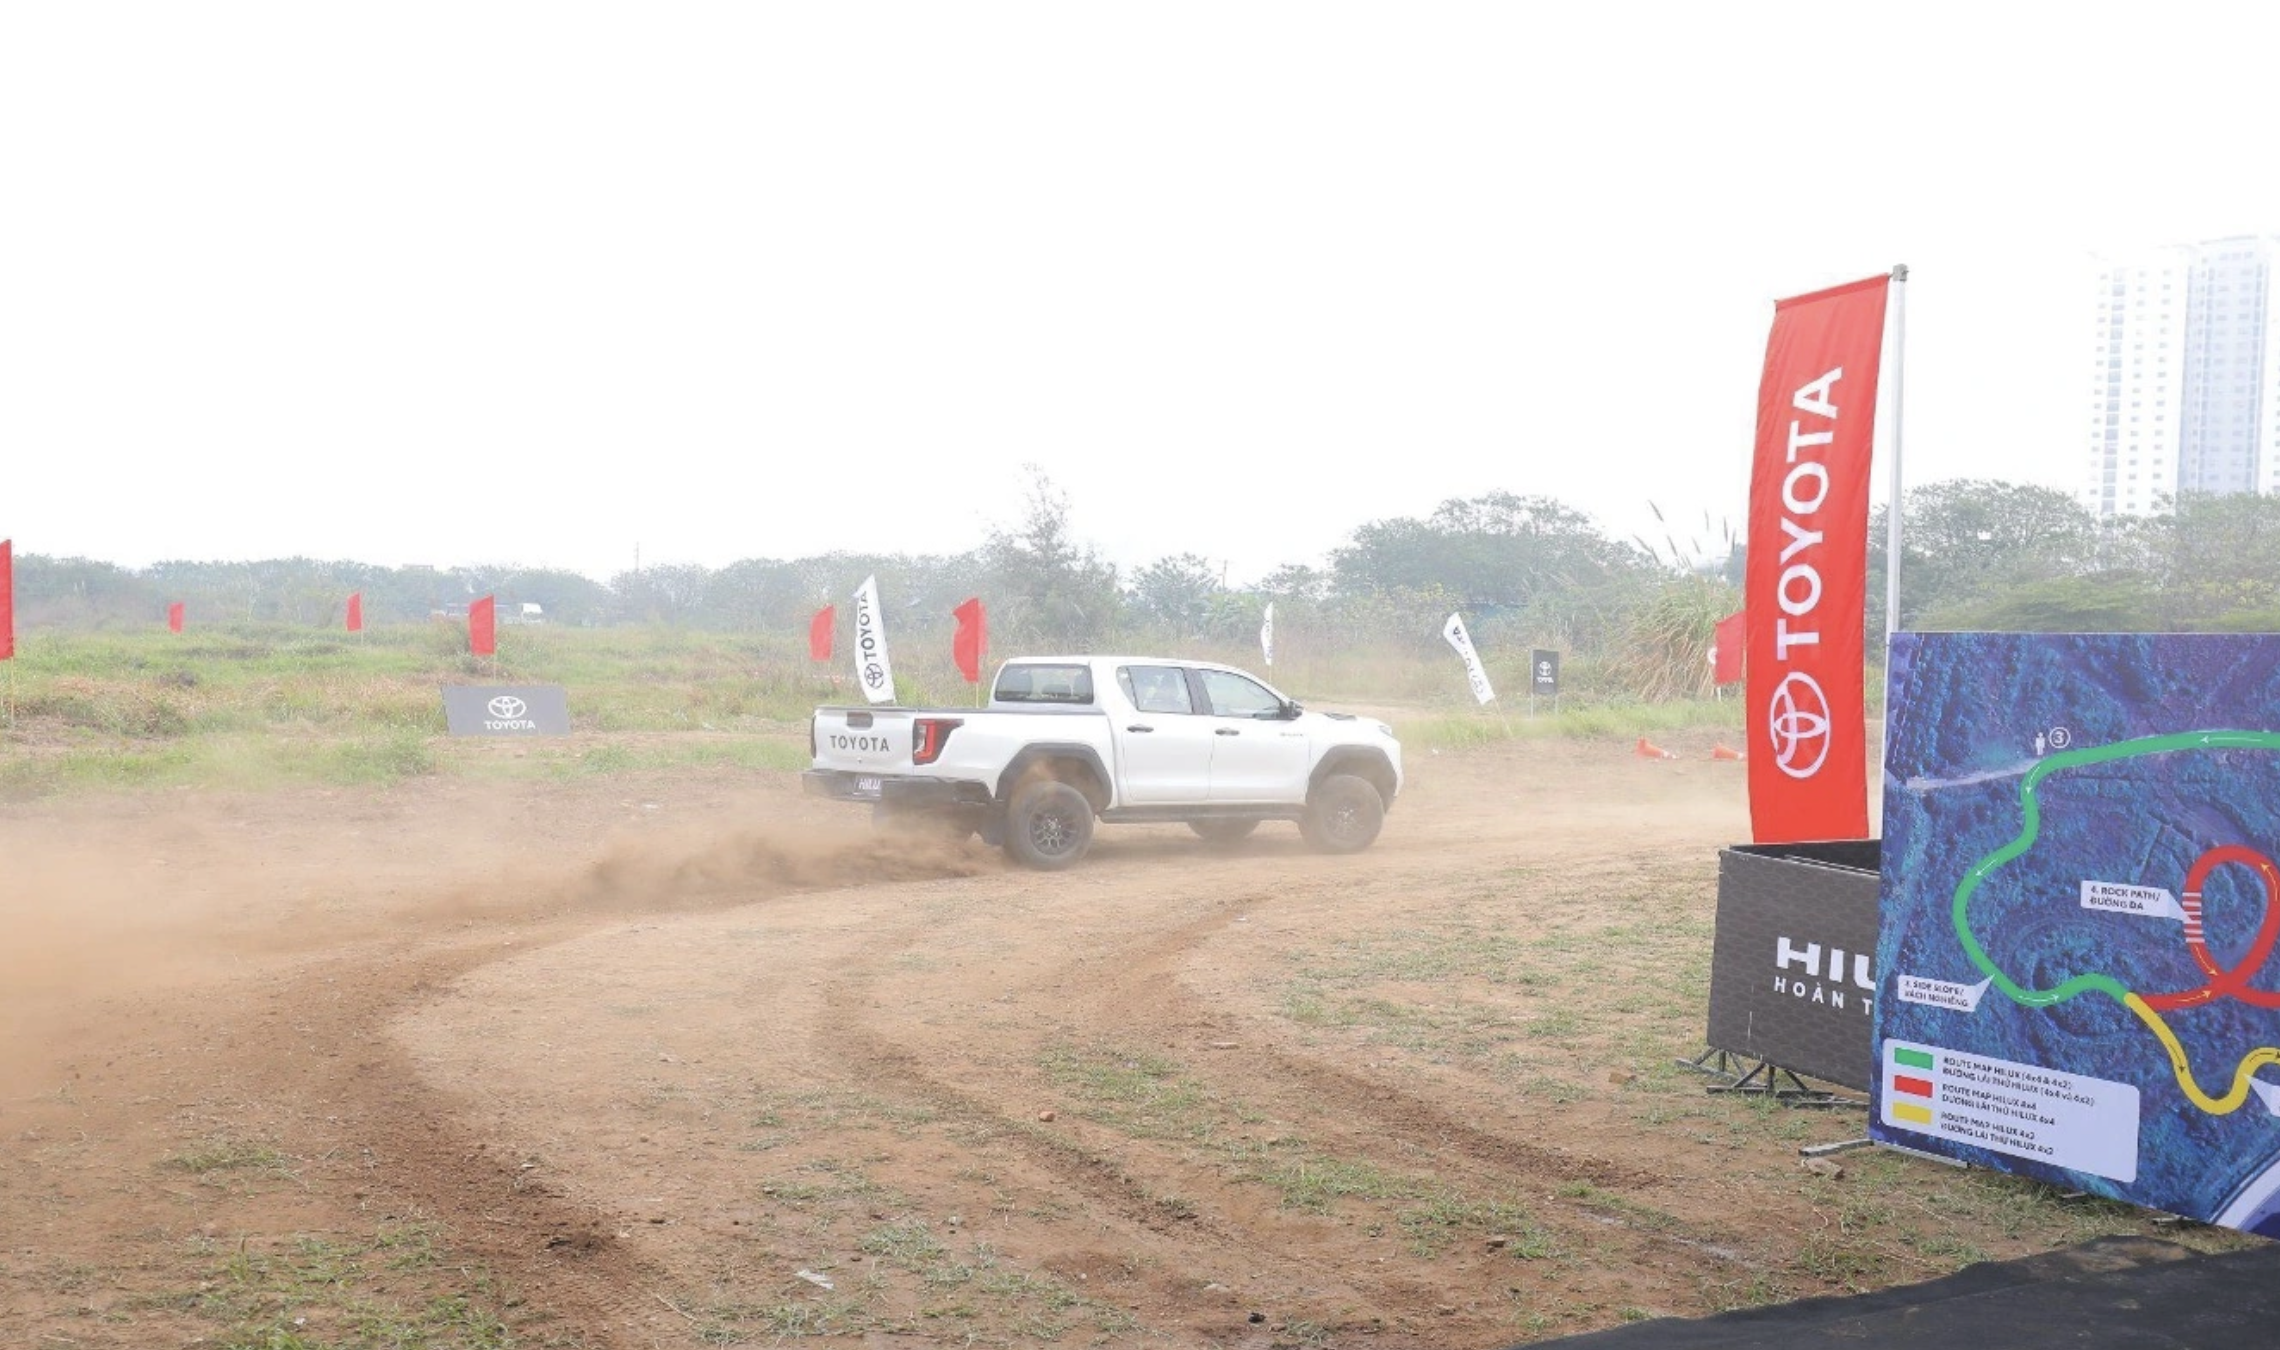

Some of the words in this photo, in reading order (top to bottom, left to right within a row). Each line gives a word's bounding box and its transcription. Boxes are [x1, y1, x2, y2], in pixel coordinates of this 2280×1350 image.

[1777, 366, 1843, 661] TOYOTA
[483, 720, 536, 730] TOYOTA
[829, 735, 890, 752] TOYOTA
[2054, 730, 2064, 744] 3
[2101, 887, 2129, 898] ROCK
[1913, 980, 1932, 990] SIDE
[1774, 976, 1845, 1009] HOÀN
[1944, 1057, 1971, 1069] ROUTE
[1973, 1063, 1992, 1072] MAP
[1994, 1066, 2020, 1078] HILUX
[2012, 1081, 2038, 1093] HILUX
[1943, 1084, 1970, 1096] ROUTE
[1972, 1090, 1991, 1099] MAP
[1993, 1094, 2019, 1107] HILUX
[2011, 1109, 2038, 1122] HILUX
[1941, 1112, 1969, 1124] ROUTE
[1970, 1118, 1990, 1128] MAP
[1993, 1124, 2018, 1136] HILUX
[2010, 1139, 2037, 1151] HILUX
